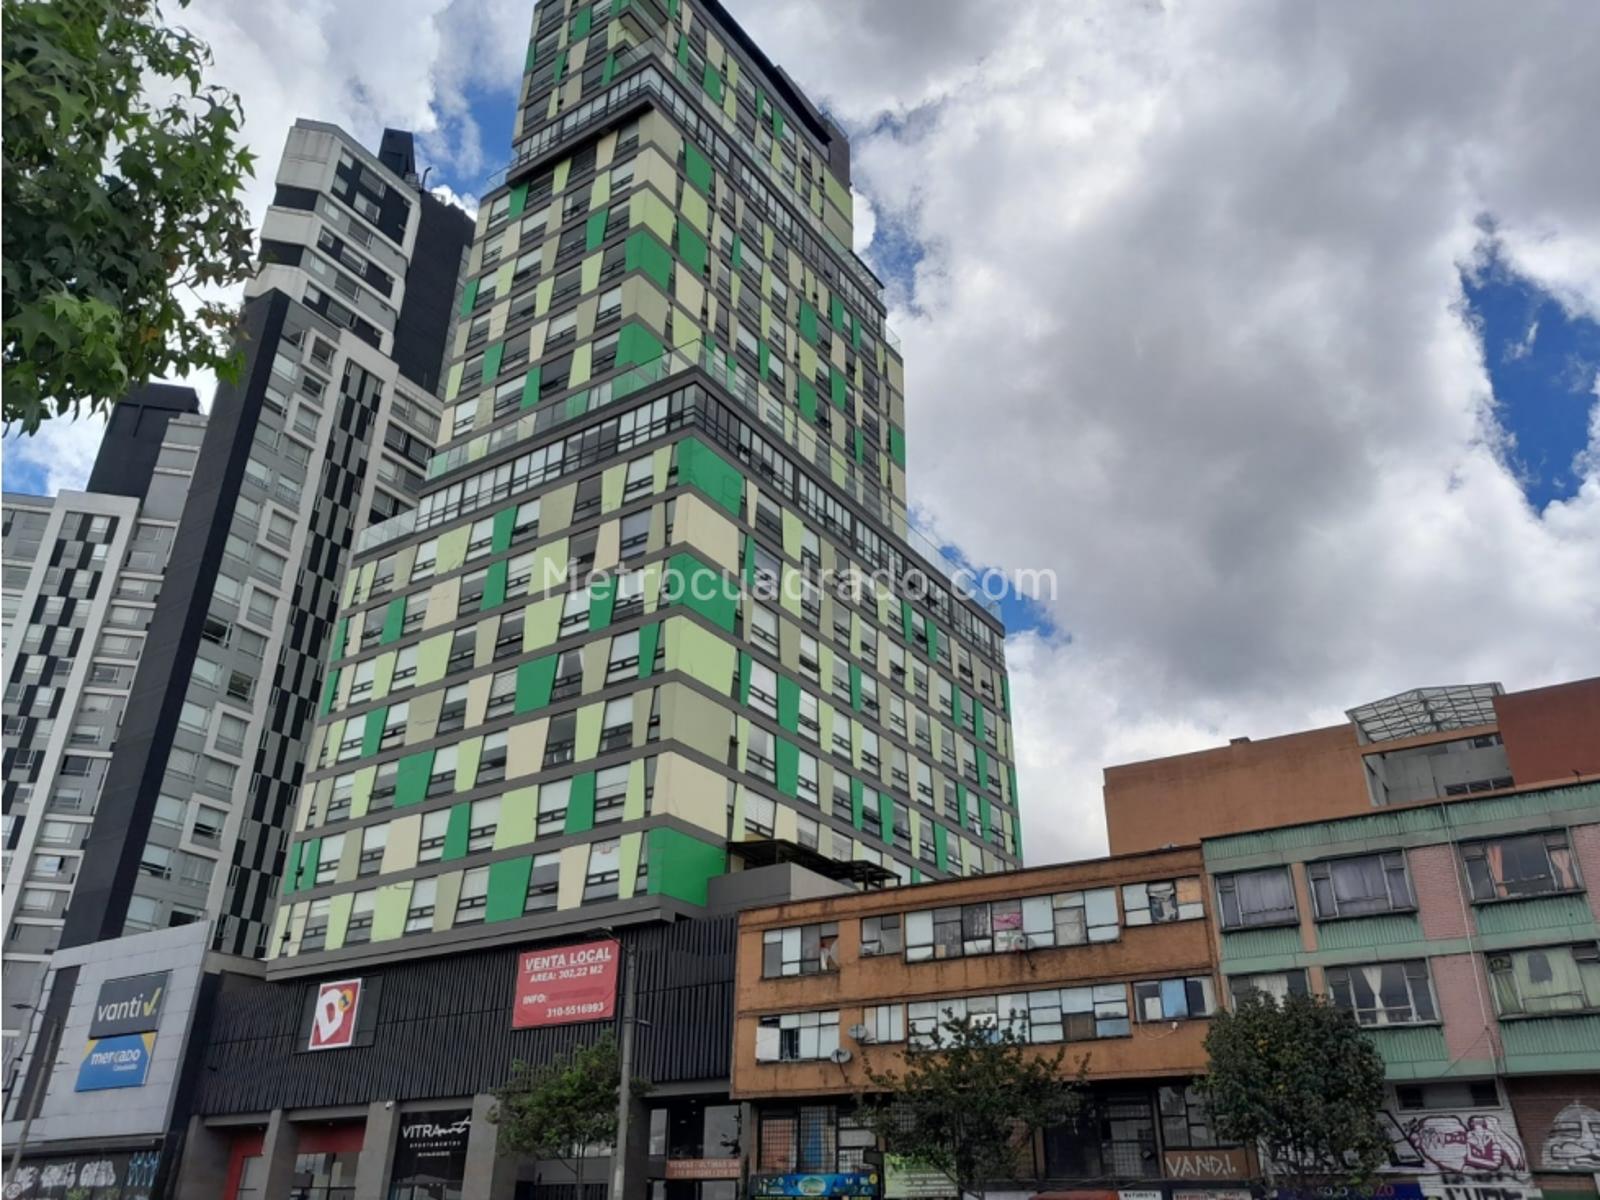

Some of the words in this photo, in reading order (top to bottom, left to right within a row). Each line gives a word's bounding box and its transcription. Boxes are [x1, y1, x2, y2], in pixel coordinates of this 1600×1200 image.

[525, 954, 566, 970] VENTA
[569, 947, 612, 964] LOCAL
[530, 972, 556, 982] AREA:
[589, 965, 603, 974] M2
[98, 993, 144, 1022] vanti
